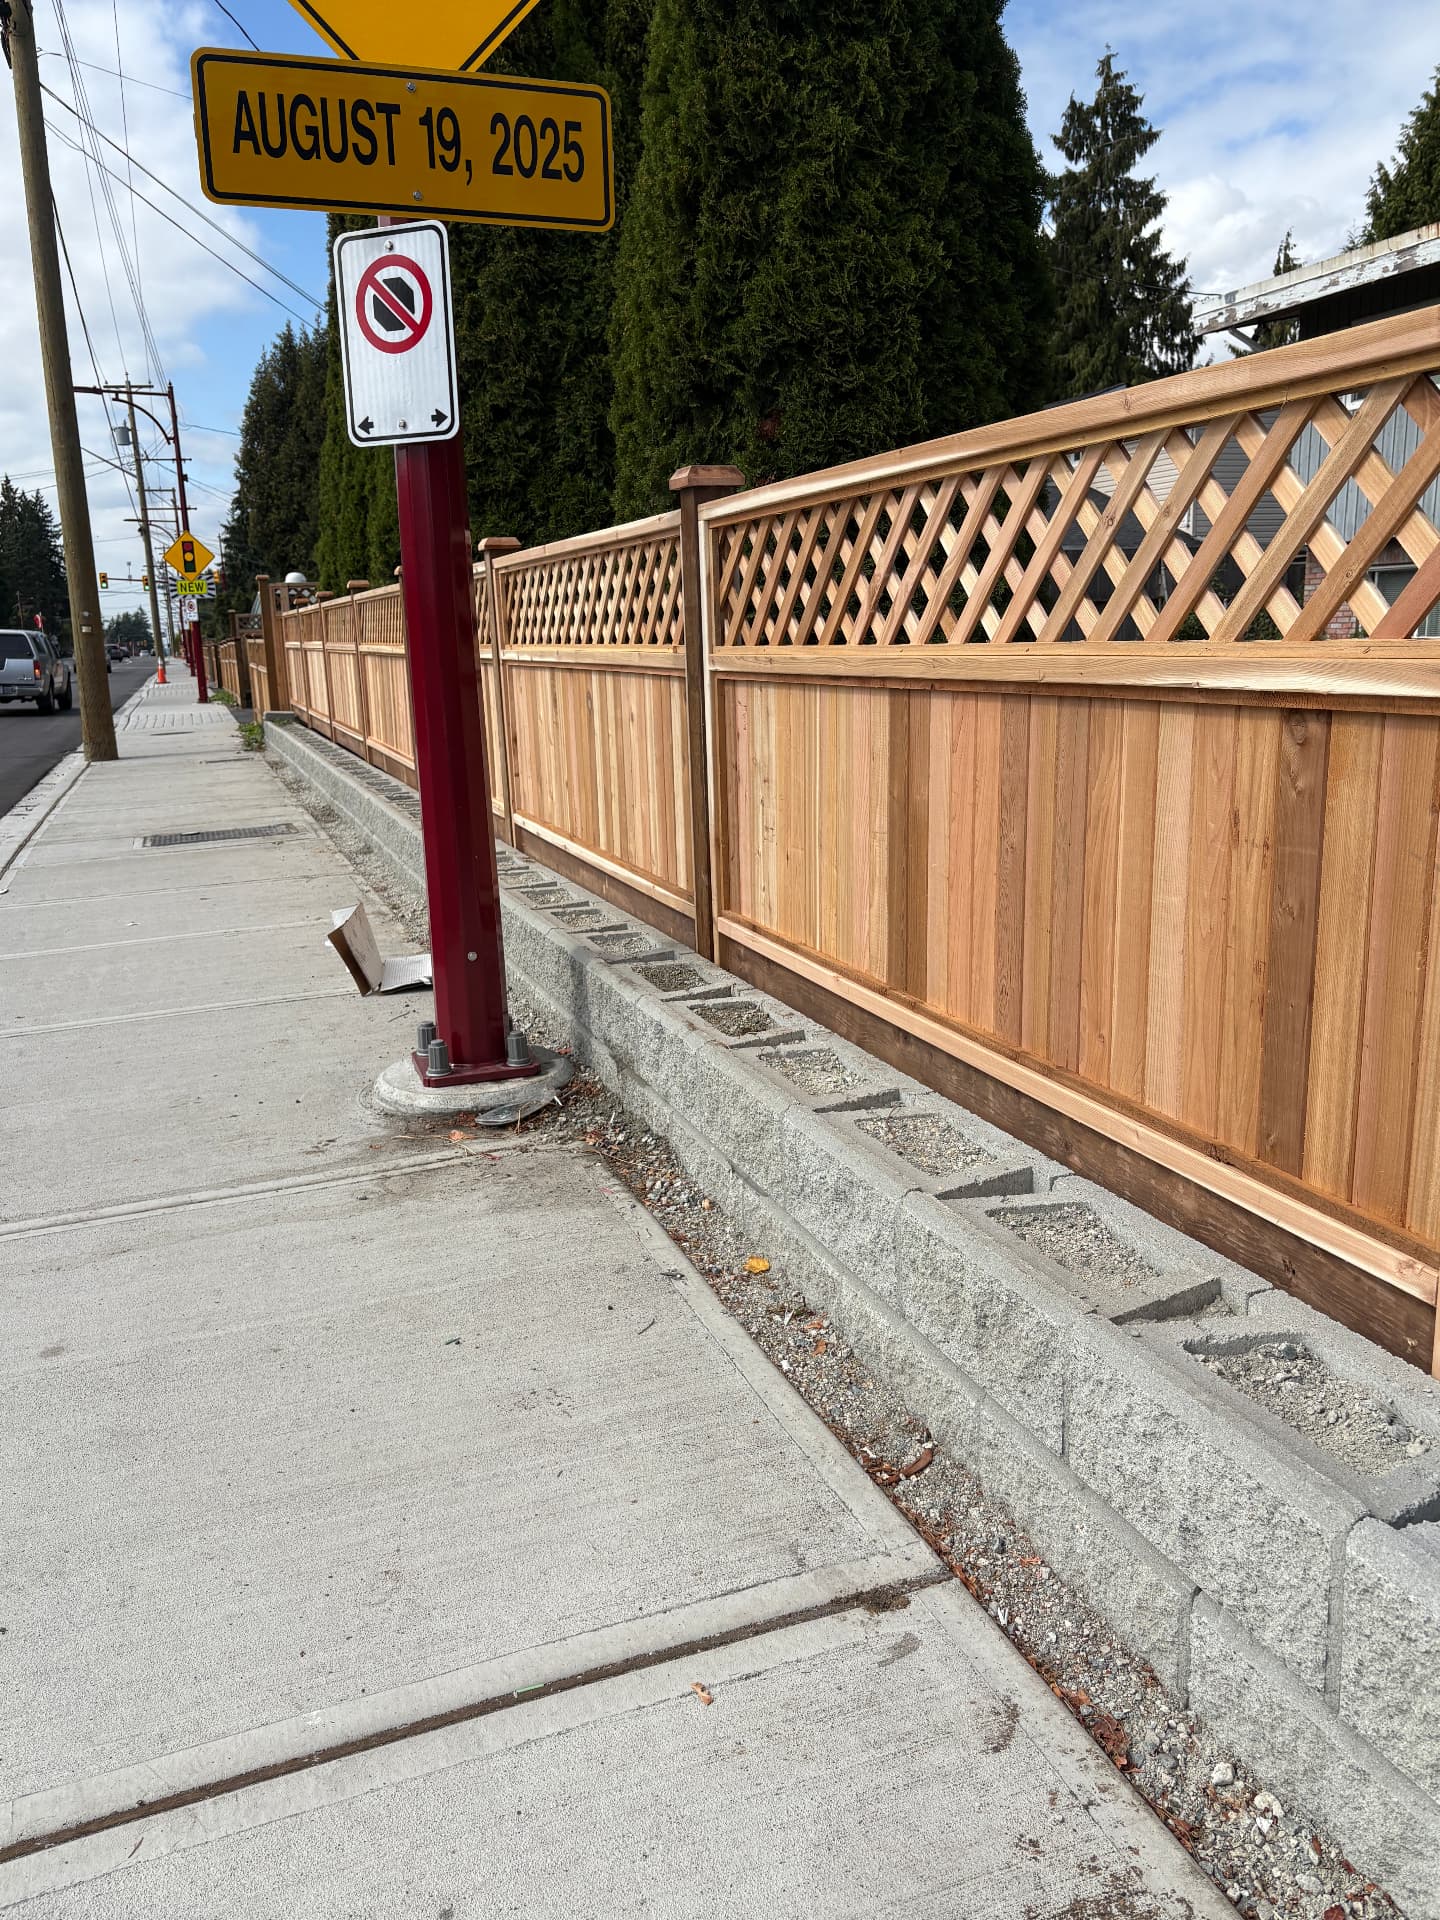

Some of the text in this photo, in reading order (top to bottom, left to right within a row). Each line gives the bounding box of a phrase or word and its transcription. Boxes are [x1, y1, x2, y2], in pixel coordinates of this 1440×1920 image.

[232, 90, 585, 186] AUGUST 19, 2025
[180, 582, 204, 593] NEW
